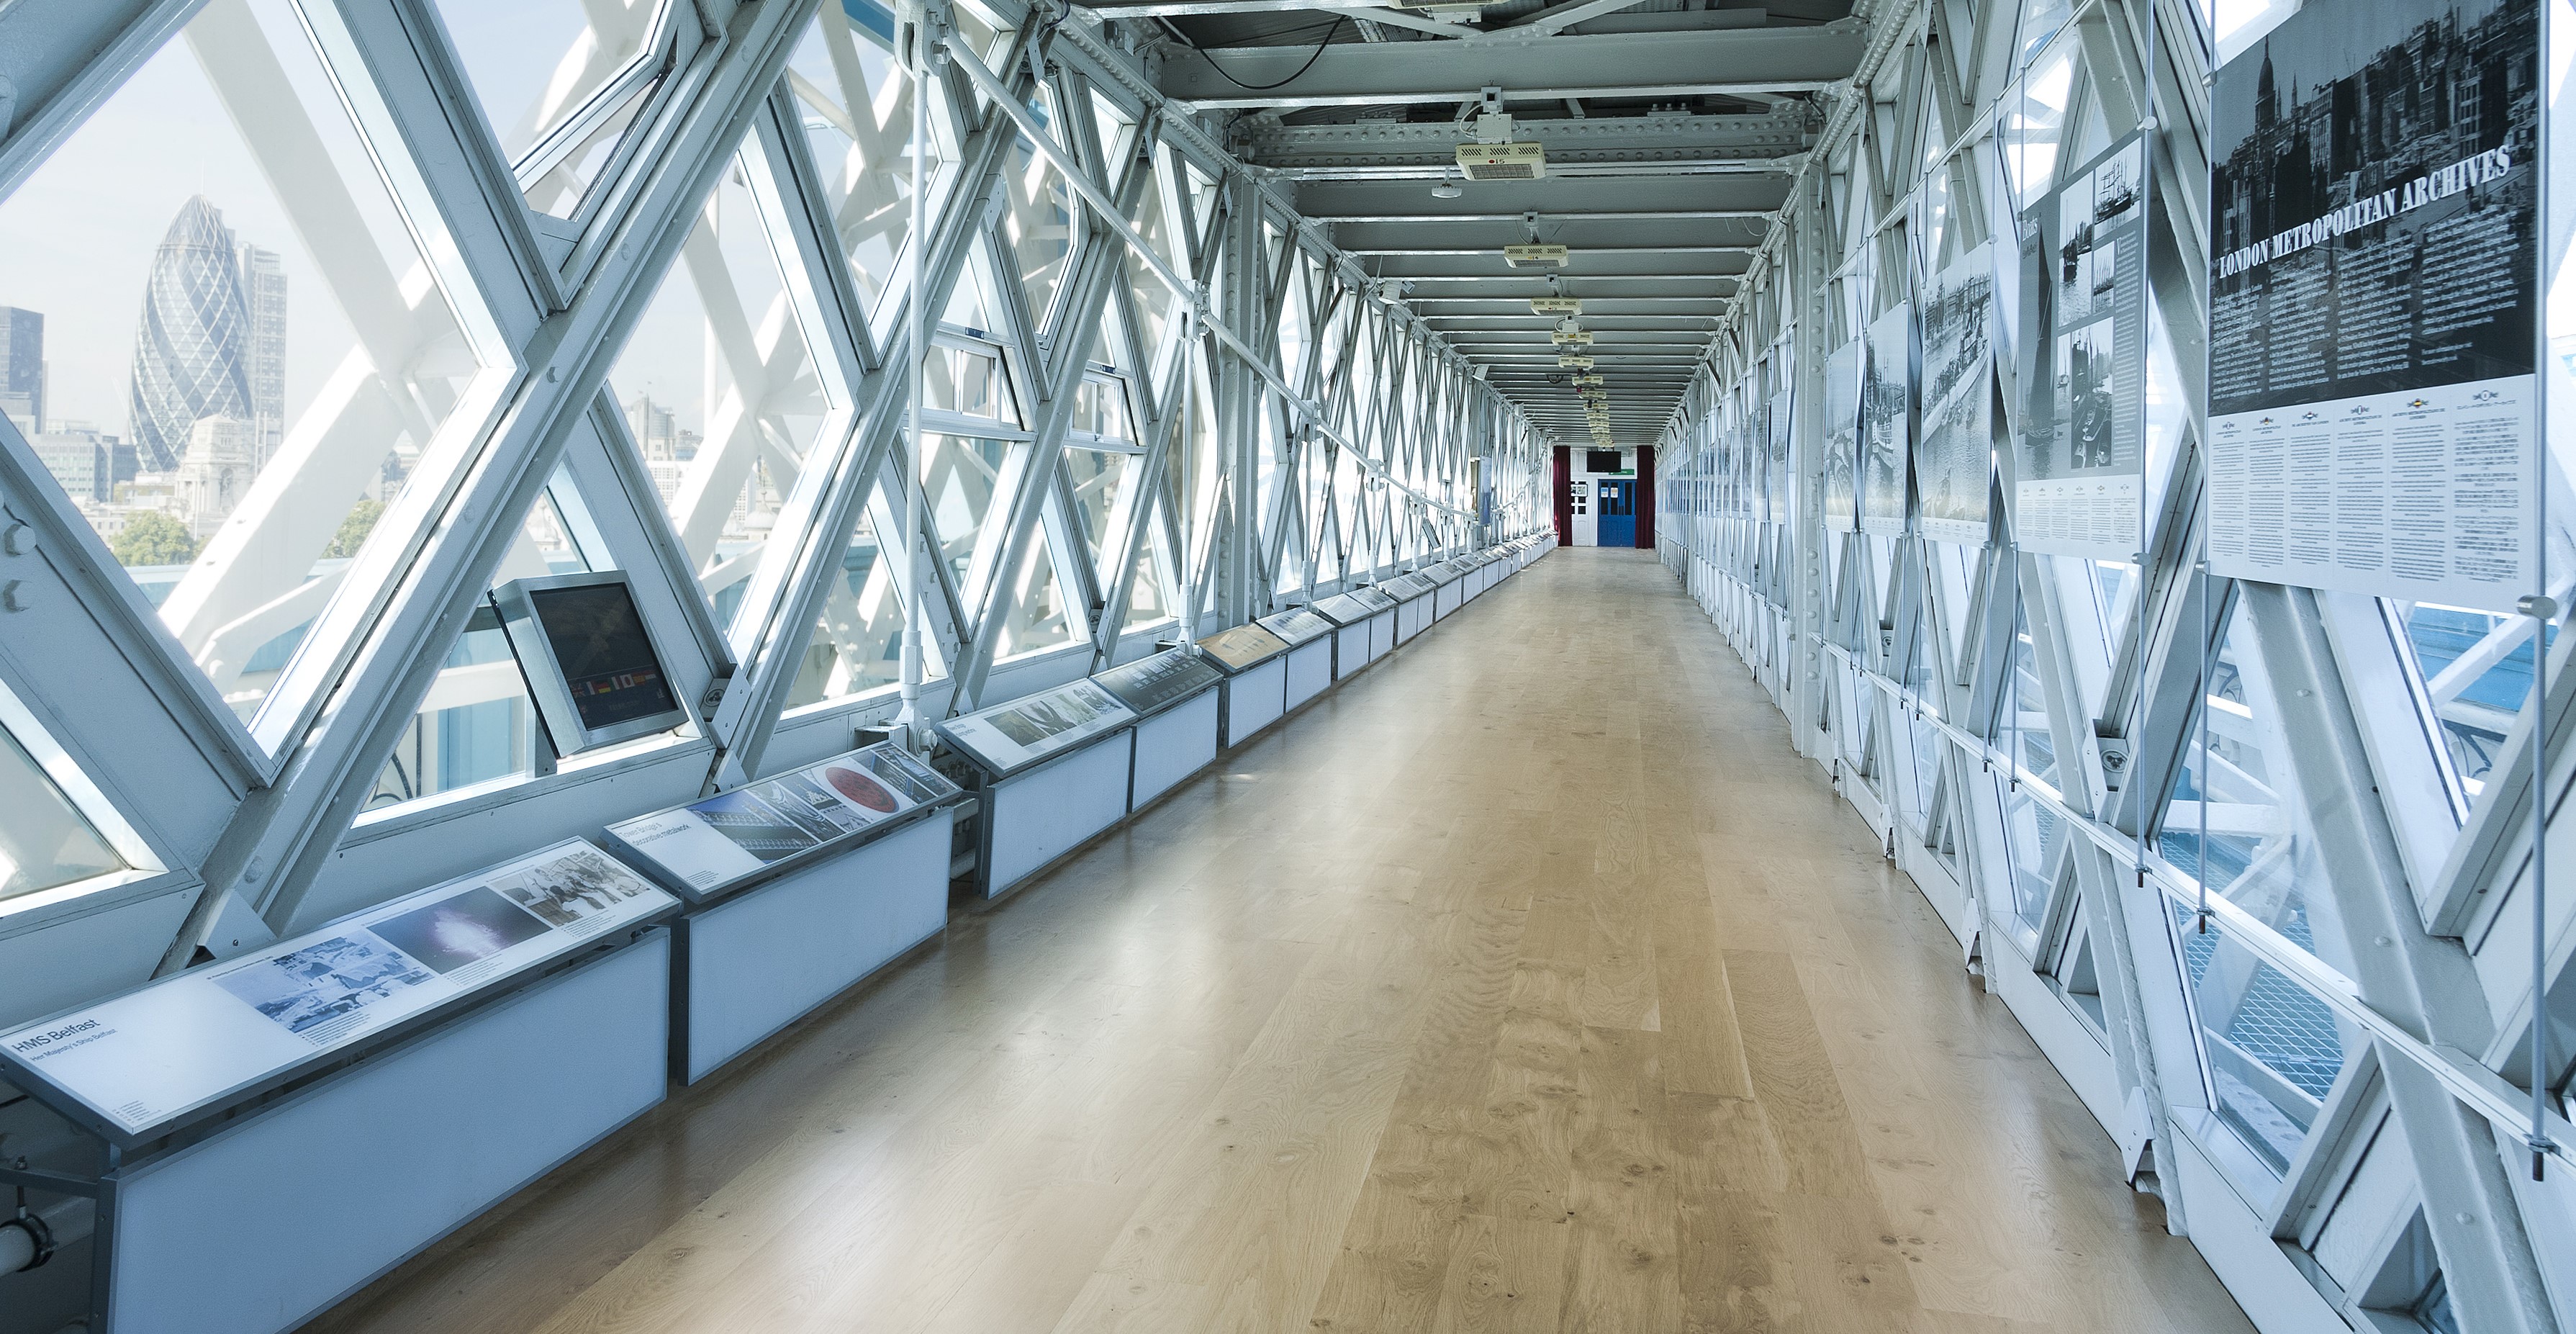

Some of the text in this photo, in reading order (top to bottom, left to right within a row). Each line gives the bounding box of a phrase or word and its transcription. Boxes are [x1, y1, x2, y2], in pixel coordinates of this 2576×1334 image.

[2023, 215, 2038, 242] Boats
[2219, 145, 2512, 279] LONDON METROPOLITAN ARCHIVES
[12, 1019, 101, 1053] HMS Belfast
[30, 1029, 117, 1062] Her Majesty's Ship Belfast
